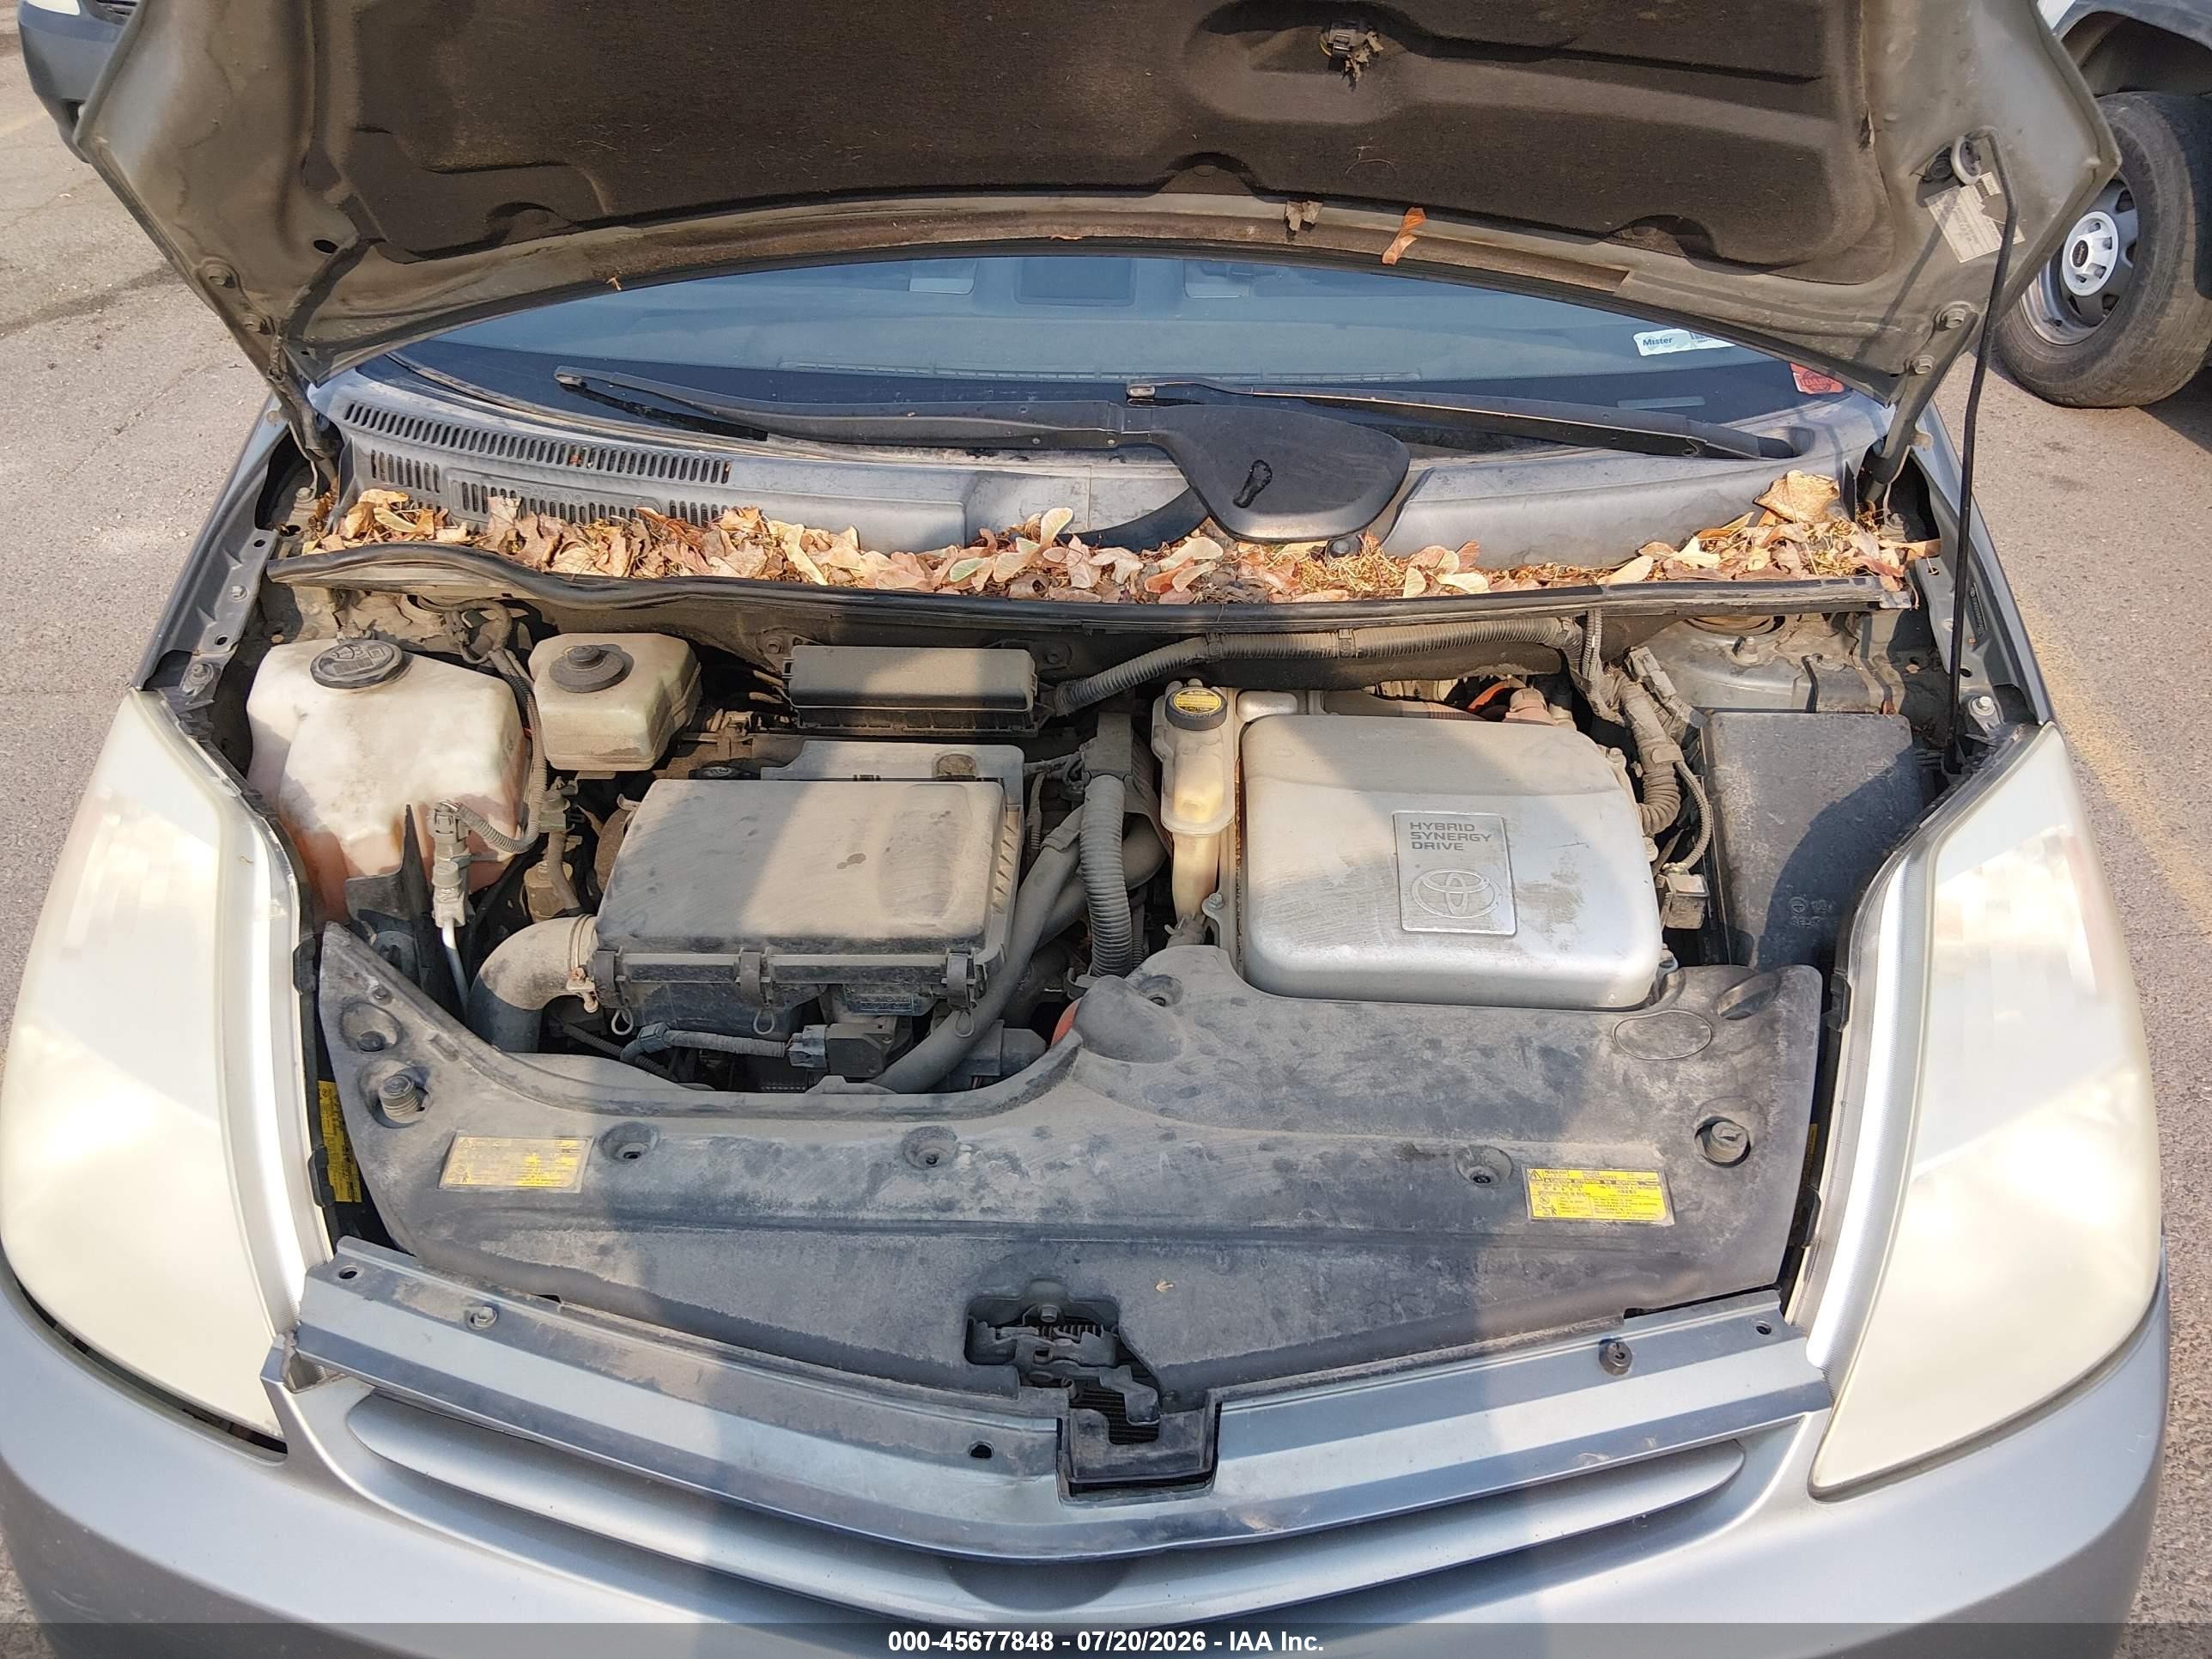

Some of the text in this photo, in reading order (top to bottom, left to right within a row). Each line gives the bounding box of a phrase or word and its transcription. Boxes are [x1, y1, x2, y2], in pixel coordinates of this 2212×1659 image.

[1642, 337, 1674, 346] Mister
[1409, 822, 1475, 832] HYBRID
[1410, 832, 1492, 842] SYNERGY
[1411, 842, 1464, 851] DRIVE
